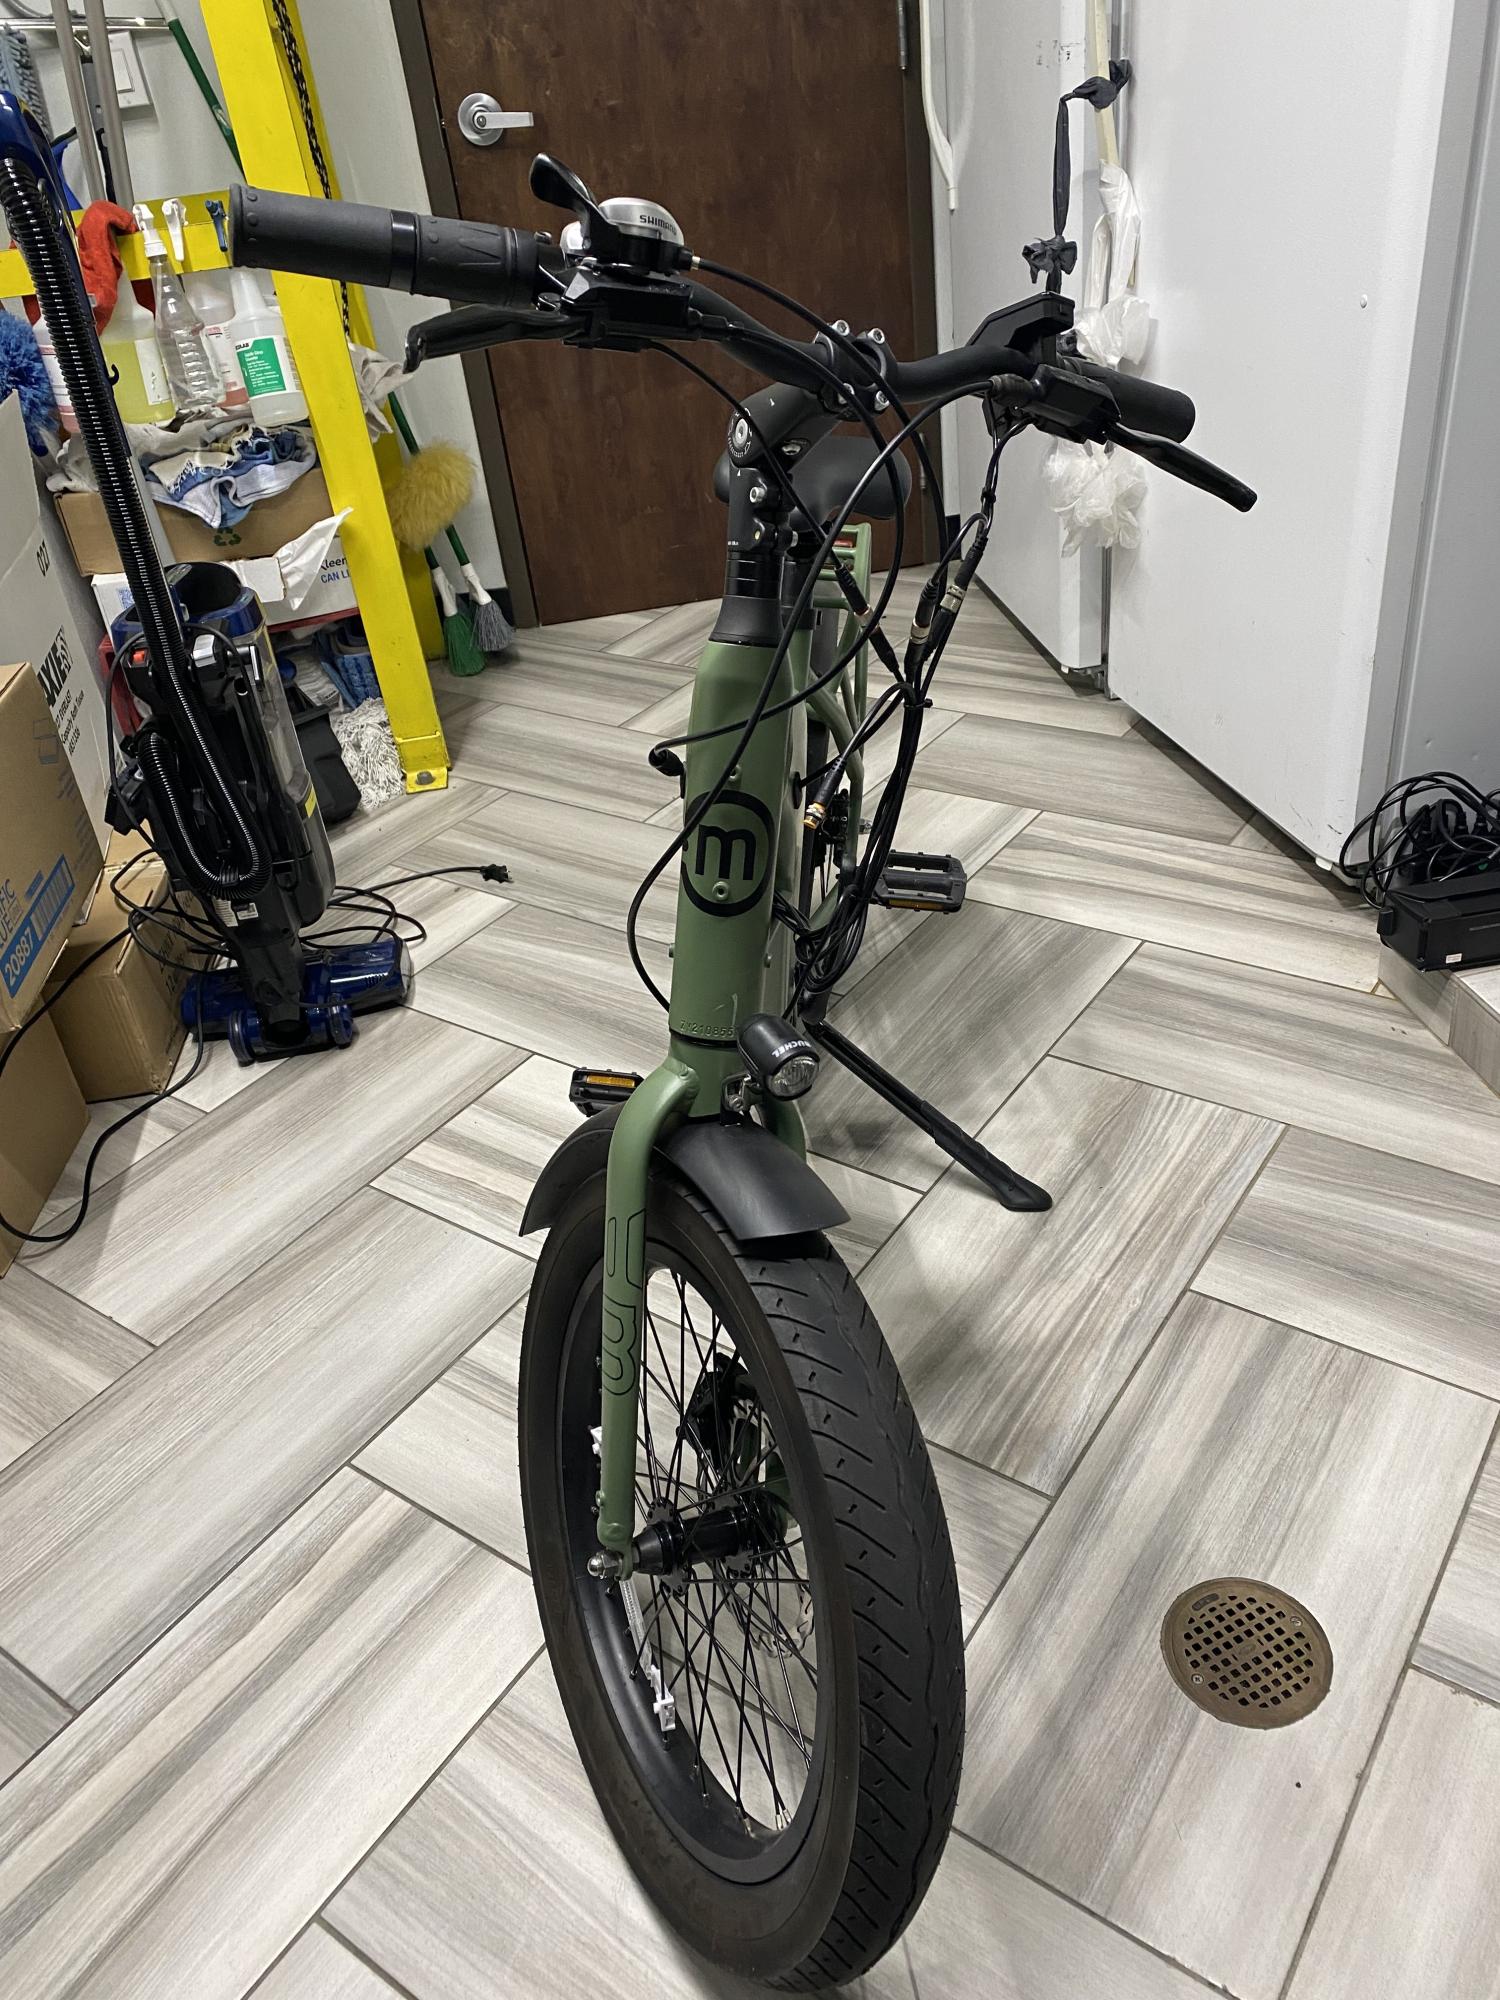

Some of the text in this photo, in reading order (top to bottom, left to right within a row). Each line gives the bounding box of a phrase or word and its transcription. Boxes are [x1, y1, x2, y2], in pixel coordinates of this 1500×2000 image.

[640, 214, 677, 236] SHIMANO
[321, 571, 340, 584] CAN
[695, 823, 757, 881] m
[4, 925, 35, 987] 20887
